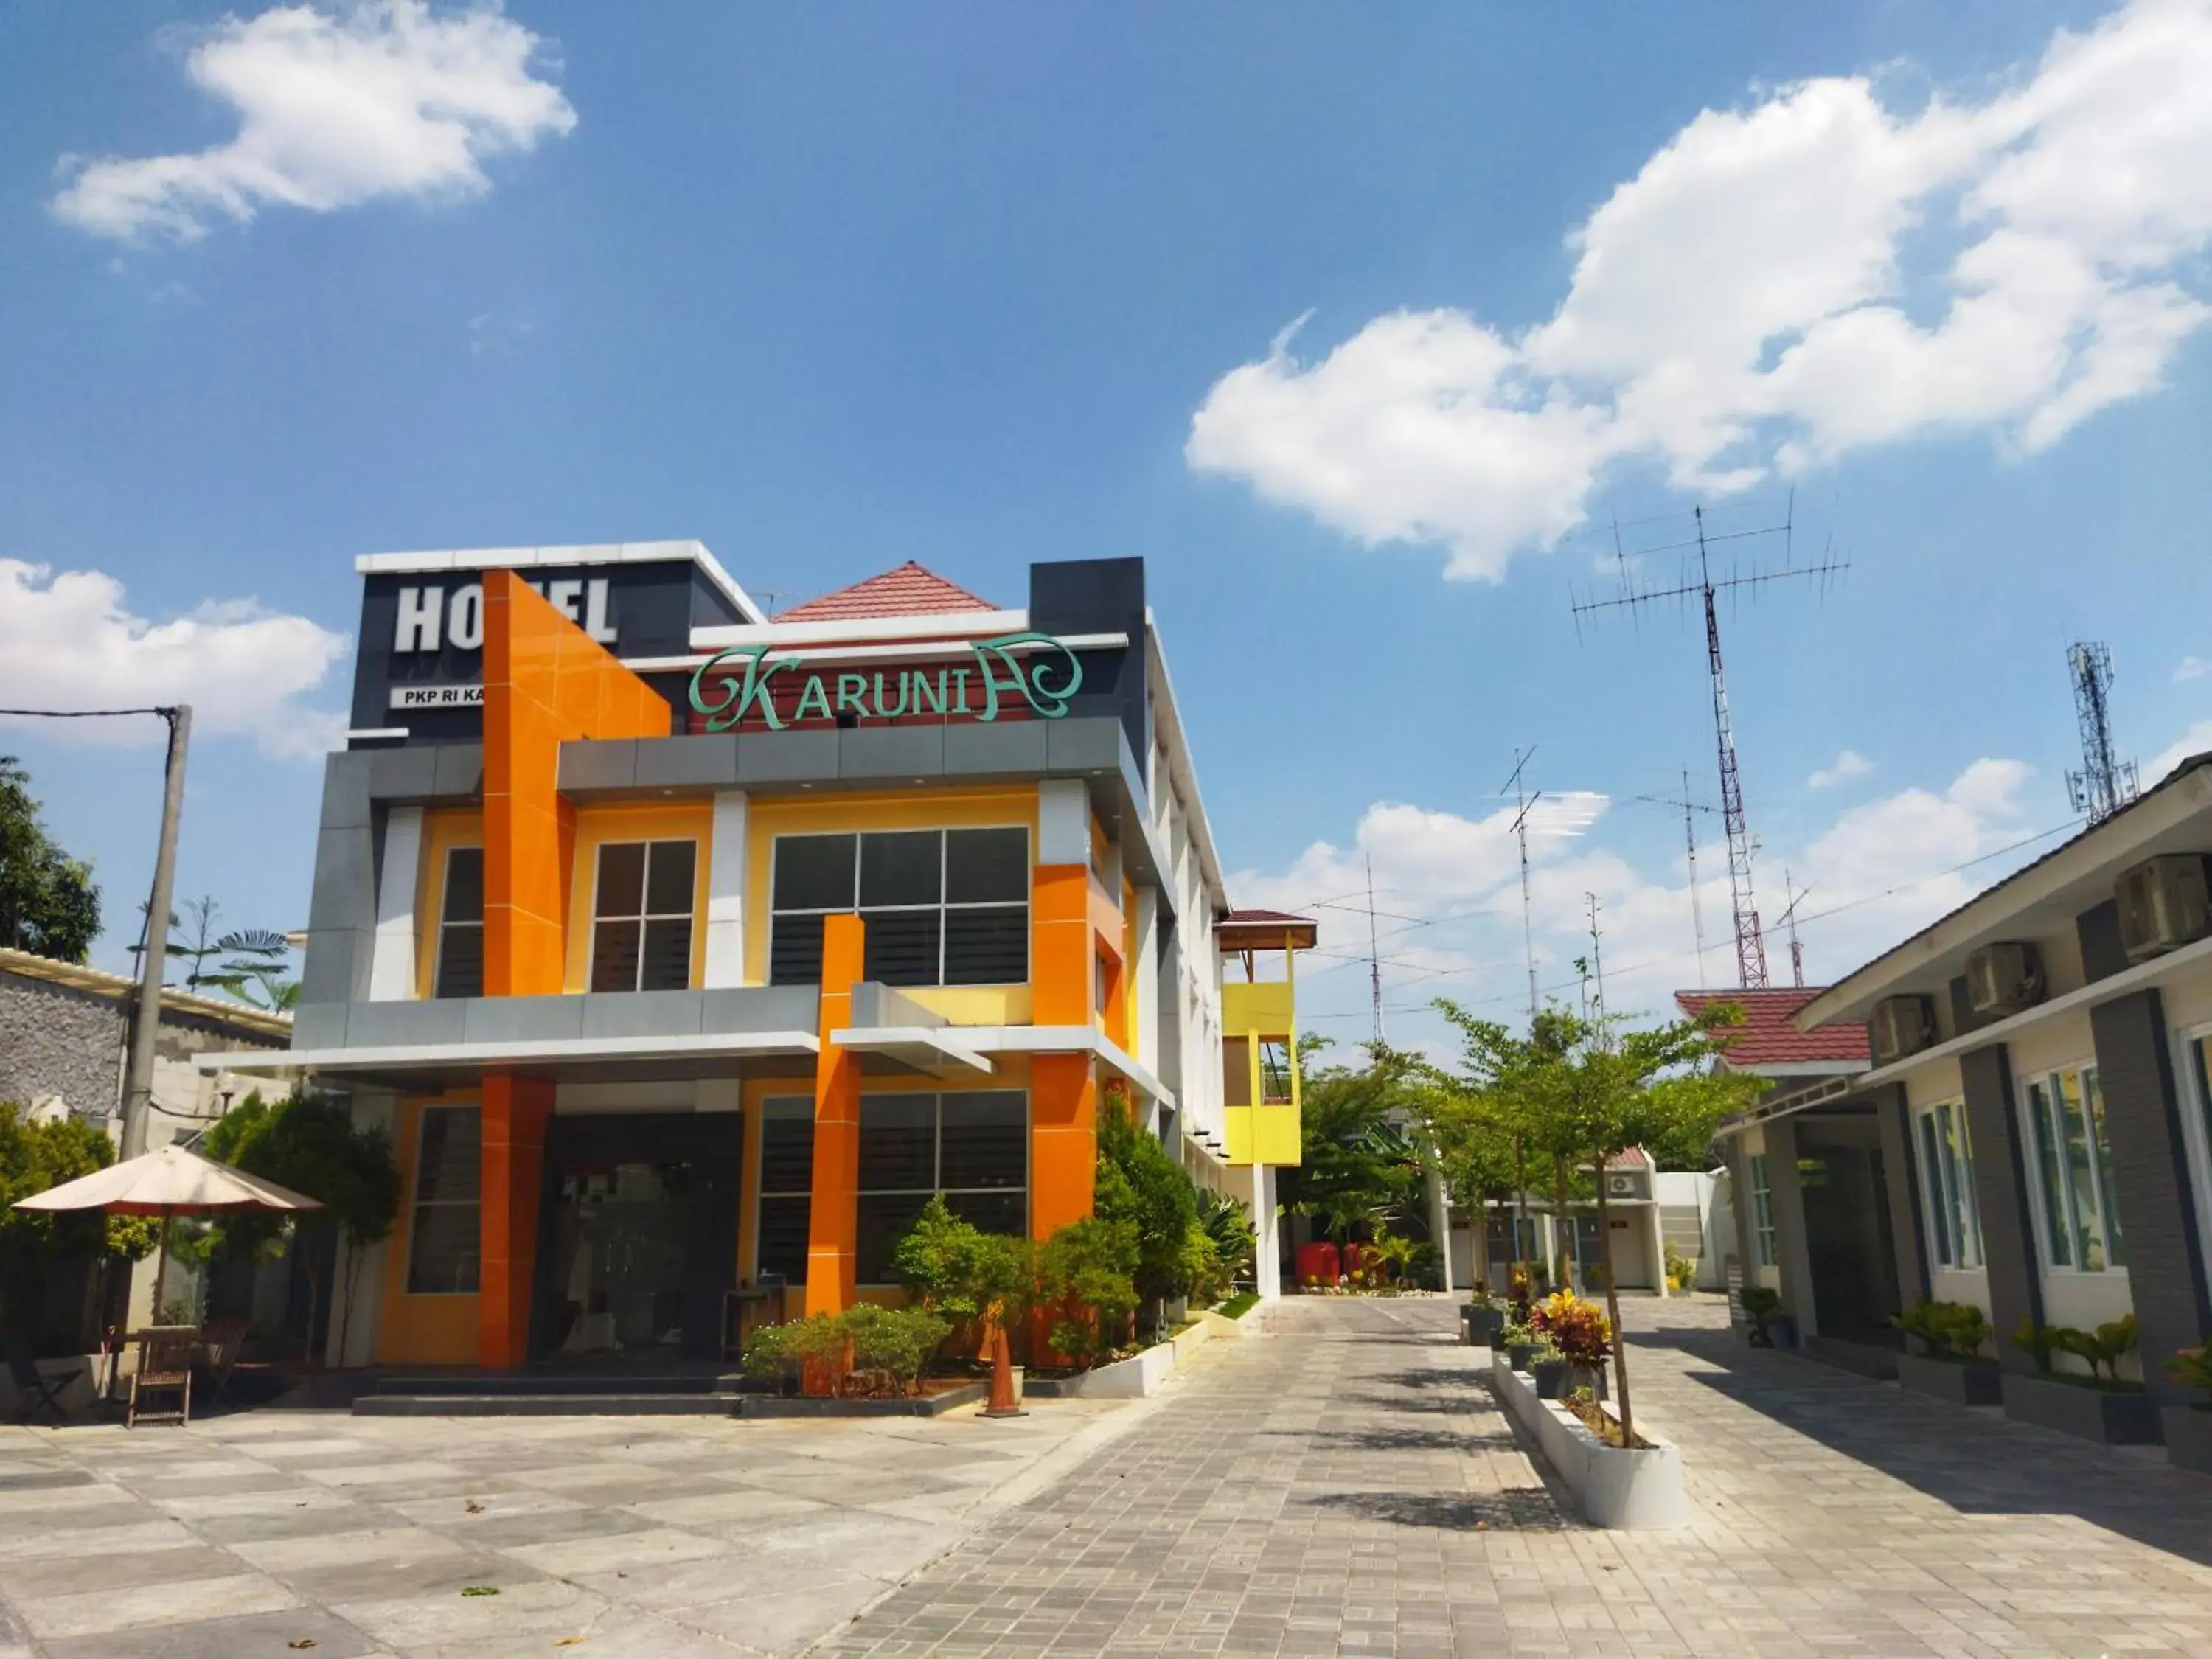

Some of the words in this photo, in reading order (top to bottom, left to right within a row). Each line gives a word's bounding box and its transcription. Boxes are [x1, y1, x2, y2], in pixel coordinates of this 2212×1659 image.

[395, 579, 617, 652] HOEL
[405, 690, 437, 703] PKP
[442, 689, 458, 702] RI
[689, 633, 1083, 731] KARUNIA
